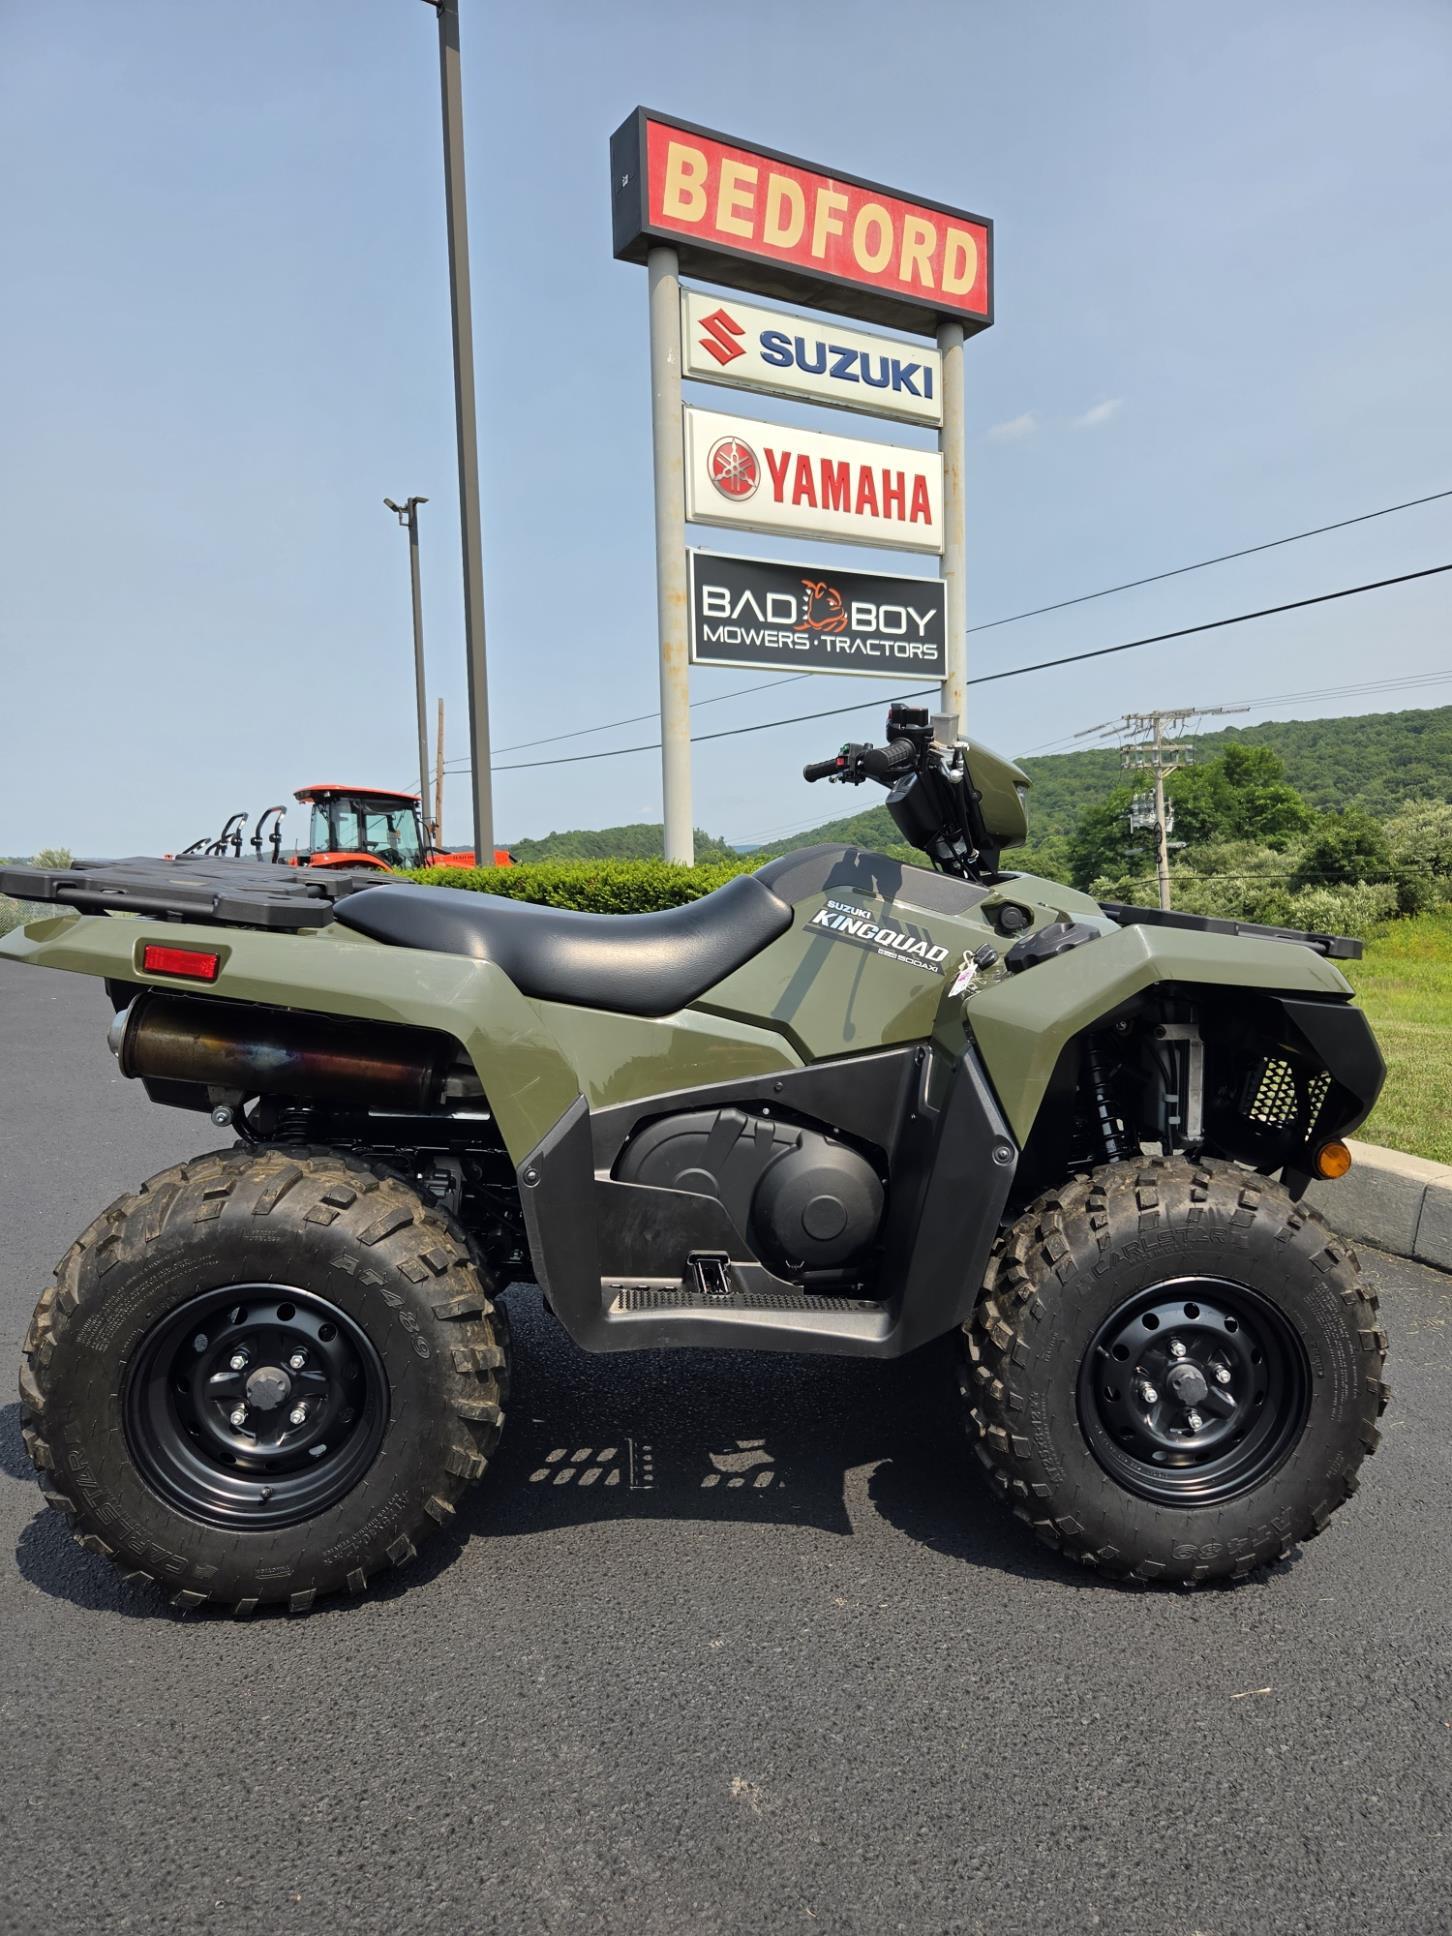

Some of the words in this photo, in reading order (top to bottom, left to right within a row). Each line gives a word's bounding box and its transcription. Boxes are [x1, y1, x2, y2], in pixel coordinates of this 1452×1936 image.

[662, 141, 978, 296] BEDFORD
[759, 330, 934, 400] SUZUKI
[763, 447, 933, 526] YAMAHA
[702, 584, 798, 625] BAD
[851, 601, 937, 637] BOY
[703, 624, 810, 650] MOWERS
[821, 635, 938, 660] TRACTORS
[812, 909, 949, 962] KINGQUAD
[827, 899, 871, 919] SUZUKI
[1090, 1226, 1227, 1279] CARLSTAR
[68, 1450, 189, 1575] CARLSTAR
